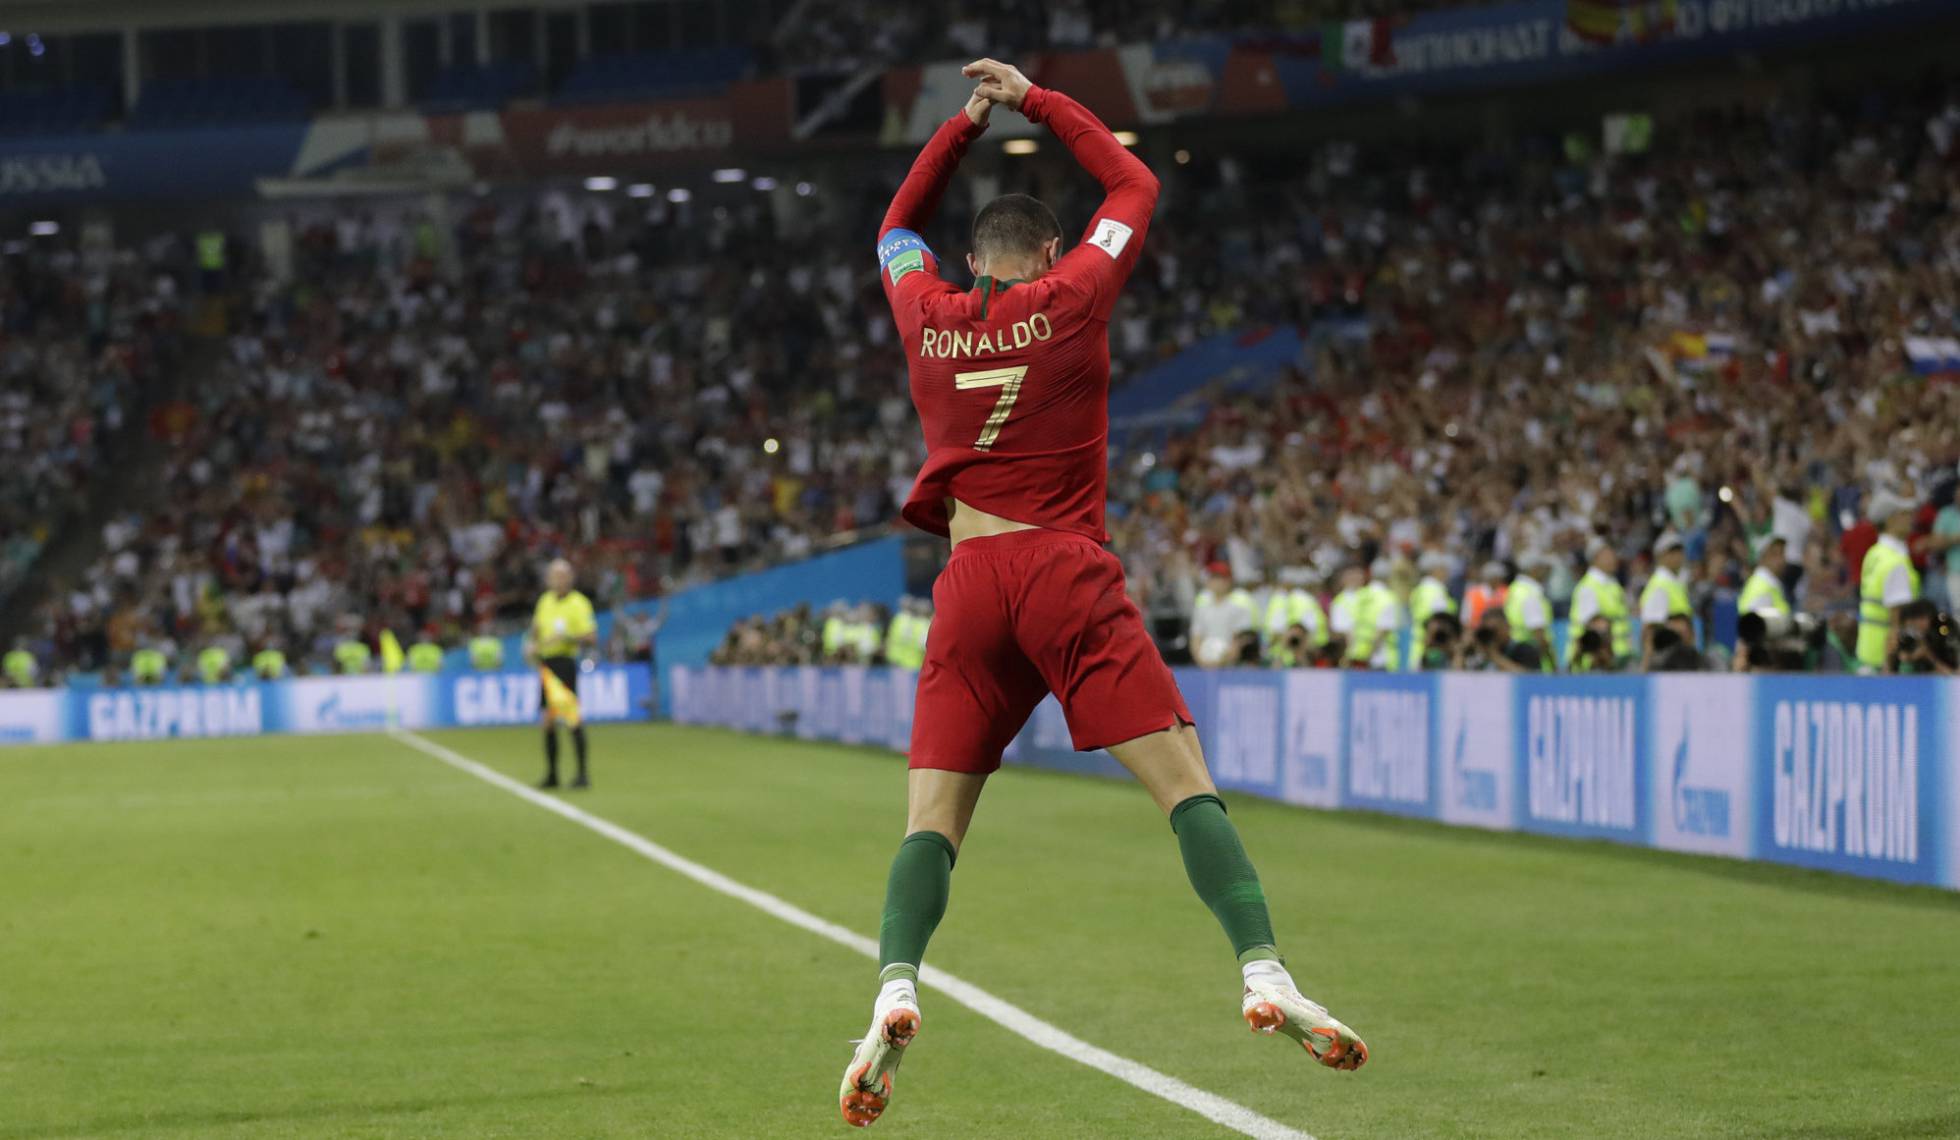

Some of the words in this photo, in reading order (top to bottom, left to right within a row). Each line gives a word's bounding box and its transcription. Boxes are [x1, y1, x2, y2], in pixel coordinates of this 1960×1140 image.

[920, 312, 1053, 359] RONALDO
[954, 365, 1029, 452] 7
[89, 688, 262, 742] GAZPROM
[1528, 694, 1636, 831] GAZPROM
[1773, 700, 1919, 864] GAZPROM
